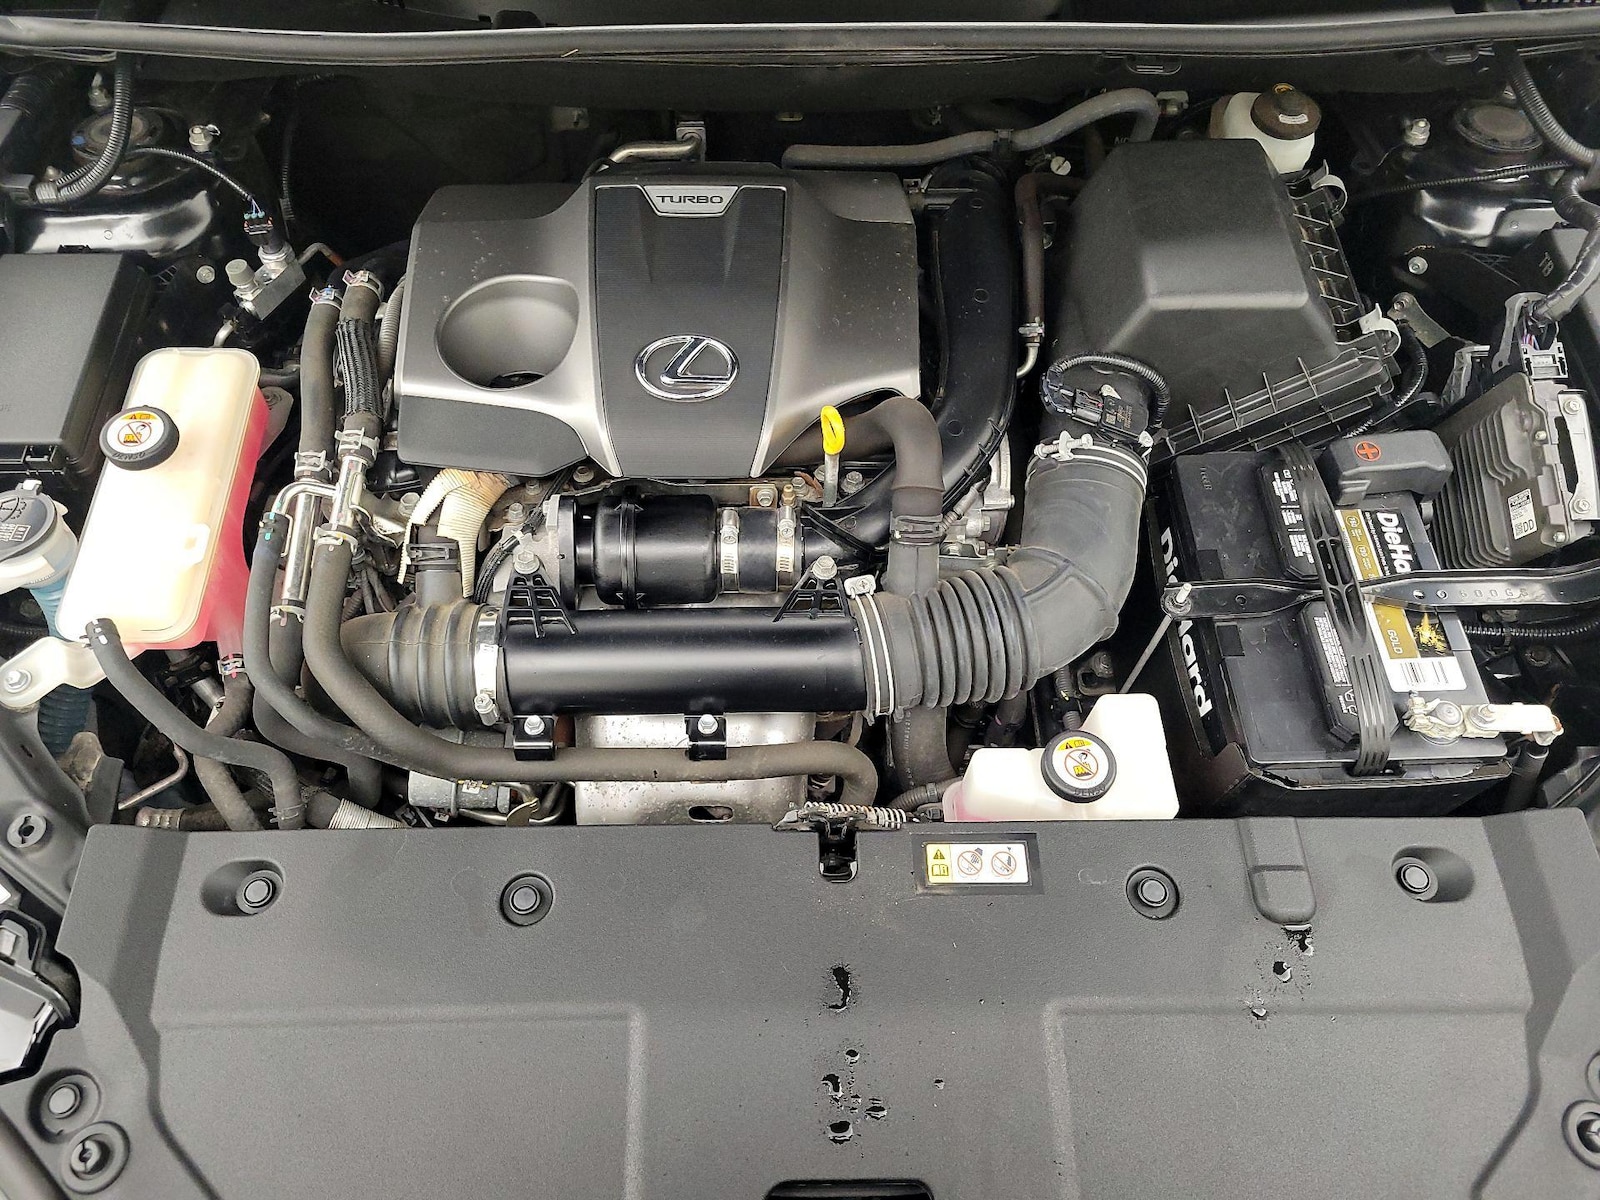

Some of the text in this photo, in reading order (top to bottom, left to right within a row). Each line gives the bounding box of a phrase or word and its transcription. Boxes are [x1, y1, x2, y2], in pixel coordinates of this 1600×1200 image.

[655, 195, 724, 204] TURBO
[112, 451, 146, 460] DENSO
[1376, 511, 1414, 574] DieHa
[1387, 629, 1404, 655] GOLD
